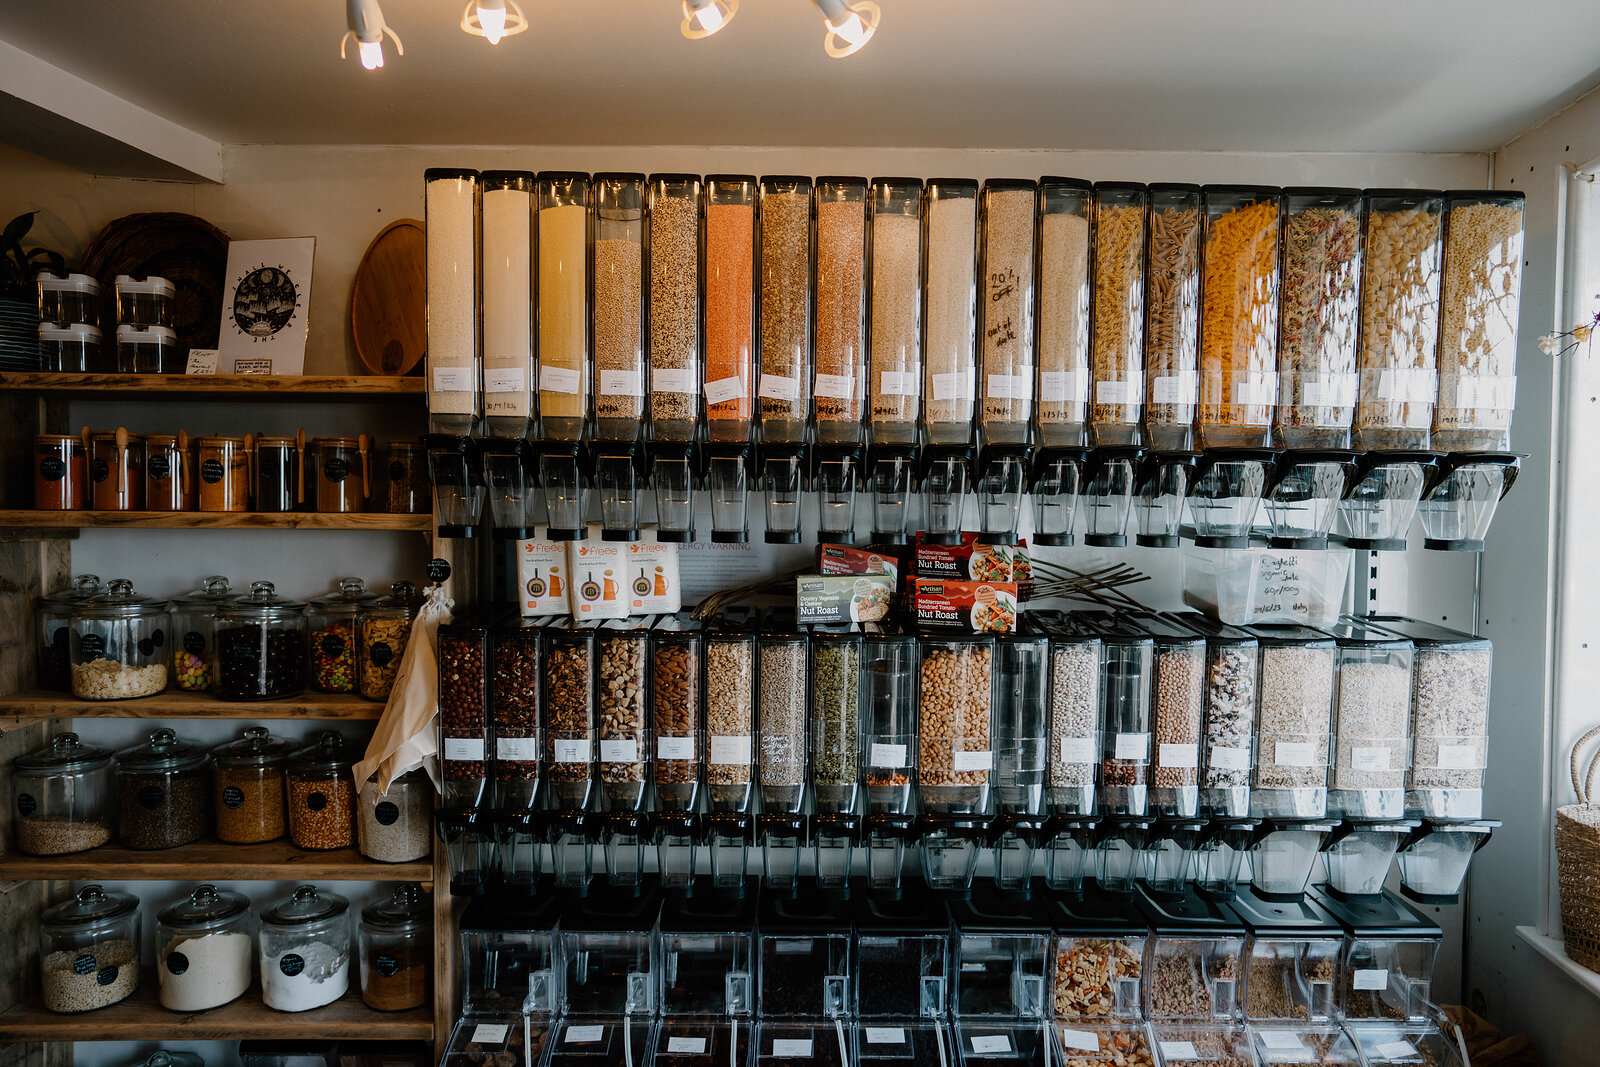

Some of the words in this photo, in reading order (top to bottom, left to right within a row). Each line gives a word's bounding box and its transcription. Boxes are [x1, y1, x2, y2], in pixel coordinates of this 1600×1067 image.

[536, 543, 564, 553] freee
[590, 546, 618, 556] freee
[641, 542, 668, 553] freee
[678, 543, 705, 551] LERGY
[708, 542, 751, 551] WARNING
[918, 559, 933, 569] Nut
[934, 560, 957, 570] Roast
[800, 595, 819, 603] Country
[819, 594, 840, 602] Vegetable
[918, 598, 951, 606] Mediterranean
[800, 606, 815, 615] Nut
[816, 605, 839, 615] Roast
[918, 609, 933, 619] Nut
[935, 610, 959, 620] Roast
